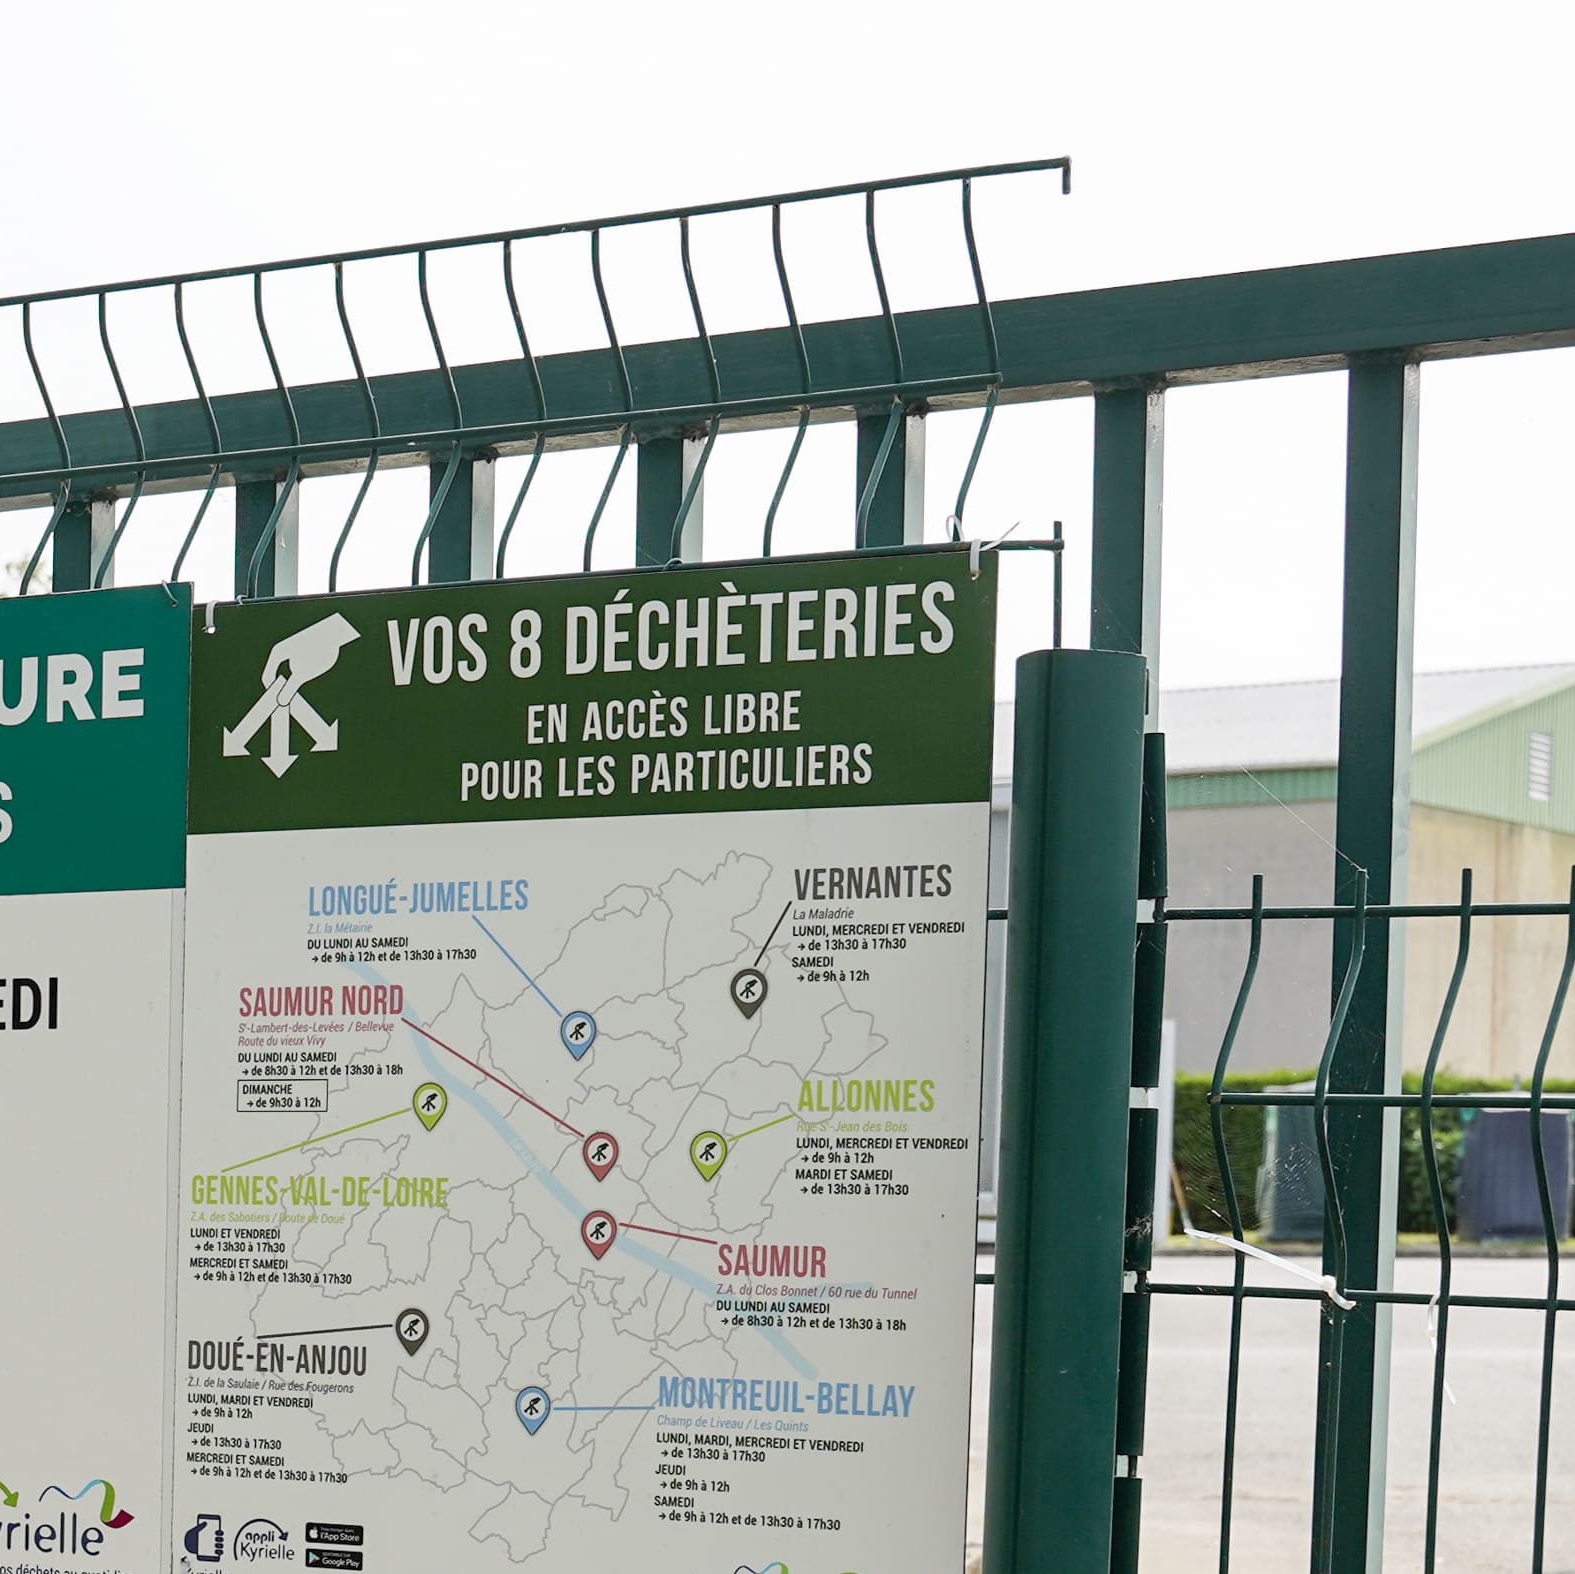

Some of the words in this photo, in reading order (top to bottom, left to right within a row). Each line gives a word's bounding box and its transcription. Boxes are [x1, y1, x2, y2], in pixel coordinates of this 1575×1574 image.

[387, 613, 488, 686] VOS
[510, 609, 542, 678] 8
[566, 581, 955, 675] DÉCHÈTERIES
[528, 704, 567, 744] EN
[582, 690, 688, 741] ACCÈS
[704, 690, 802, 735] LIBRE
[461, 759, 542, 801] POUR
[558, 755, 615, 797] LES
[631, 743, 872, 794] PARTICULIERS
[309, 878, 529, 917] LONGUÉ-JUMELLES
[793, 864, 954, 902] VERNANTES
[793, 909, 806, 920] La
[808, 908, 854, 919] Maladrie
[793, 924, 829, 938] LUNDI,
[833, 924, 889, 937] MERCREDI
[892, 923, 906, 934] ET
[908, 922, 965, 934] VENDREDI
[308, 939, 321, 950] DU
[324, 938, 353, 949] LUNDI
[355, 938, 369, 948] AU
[371, 937, 408, 948] SAMEDI
[808, 939, 821, 951] de
[825, 939, 859, 951] 13h30
[862, 938, 868, 950] à
[872, 938, 907, 950] 17h30
[238, 985, 333, 1018] SAUMUR
[341, 984, 403, 1016] NORD
[797, 1079, 937, 1113] ALLONNES
[190, 1174, 451, 1209] GENNES-VAL-DE-LOIRE
[717, 1242, 829, 1280] SAUMUR
[188, 1337, 367, 1377] DOUÉ-EN-ANJOU
[655, 1375, 915, 1418] MONTREUIL-BELLAY
[240, 1544, 296, 1562] Kyrielle
[244, 1530, 275, 1549] appli
